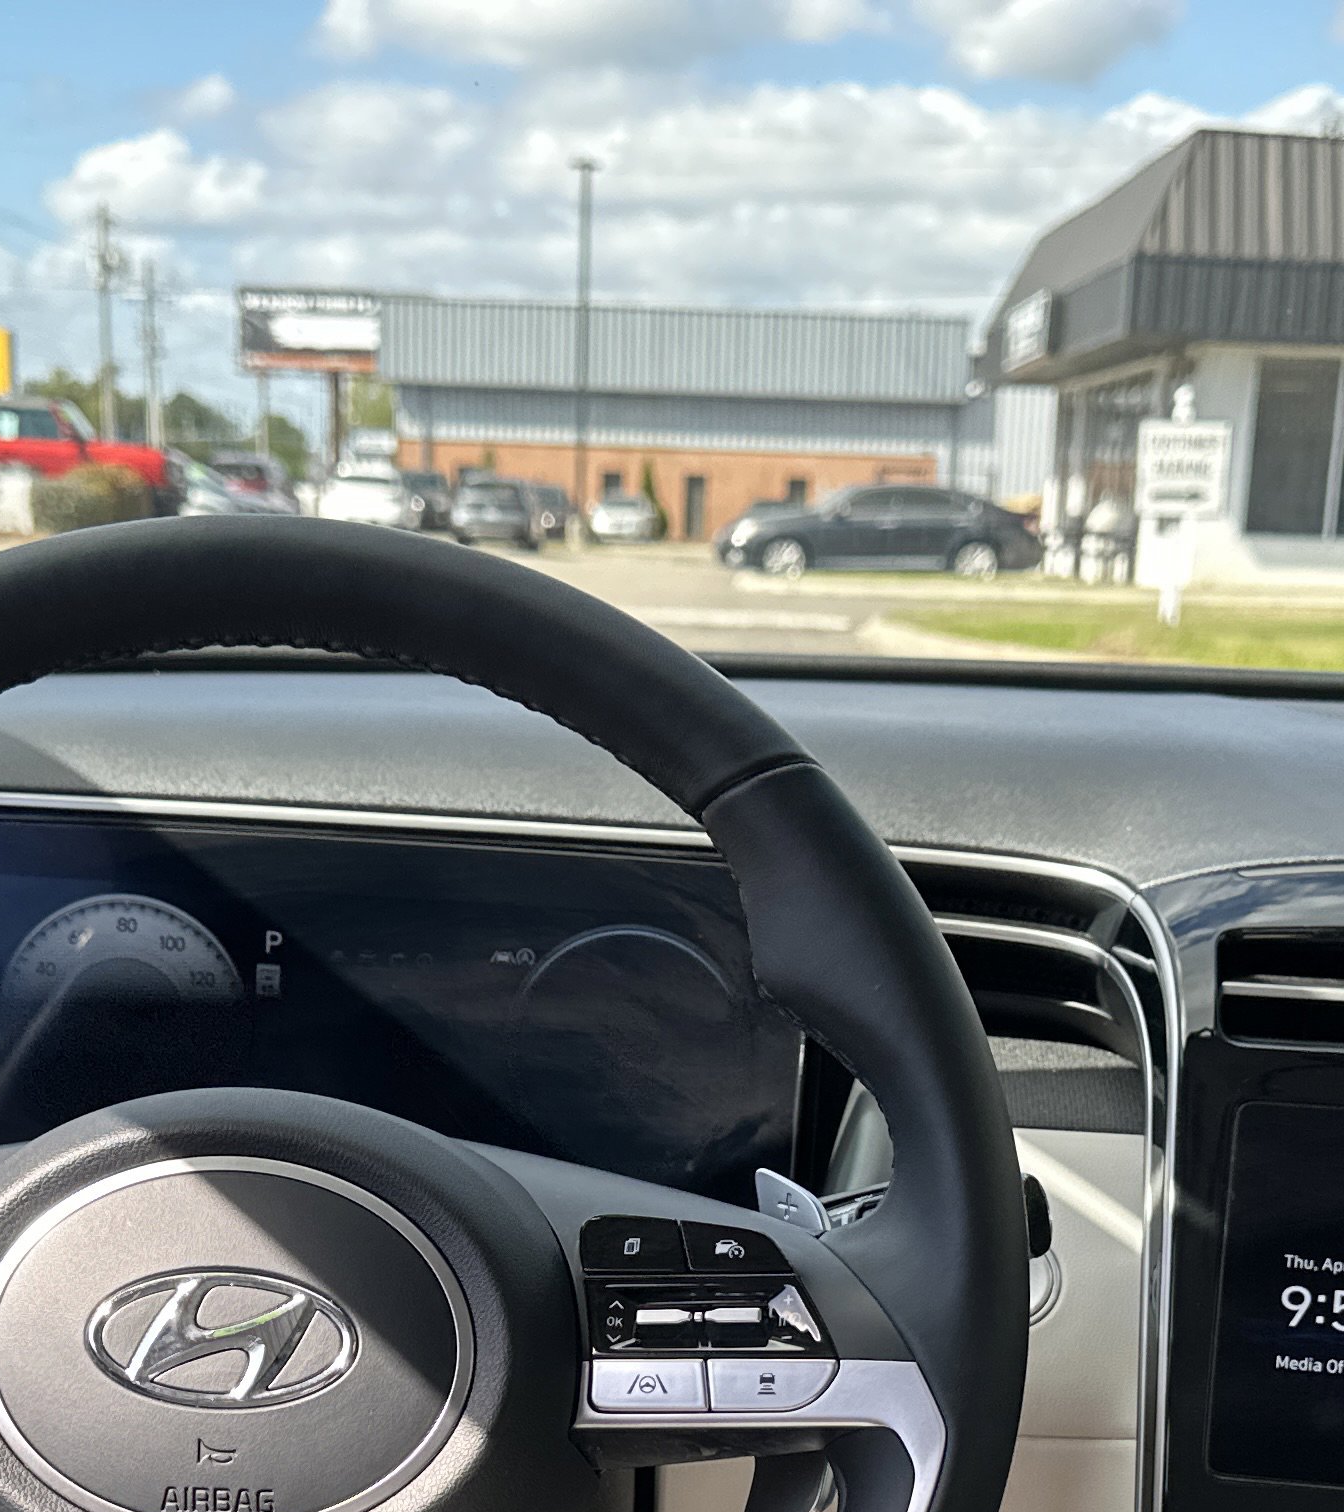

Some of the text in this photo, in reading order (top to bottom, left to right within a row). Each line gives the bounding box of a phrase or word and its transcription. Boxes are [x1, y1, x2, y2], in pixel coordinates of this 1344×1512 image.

[116, 917, 138, 933] 80
[160, 935, 186, 952] 100
[265, 930, 283, 954] P
[36, 961, 57, 977] 40
[189, 970, 216, 987] 120
[606, 1315, 623, 1329] OK
[1276, 1355, 1322, 1373] Media
